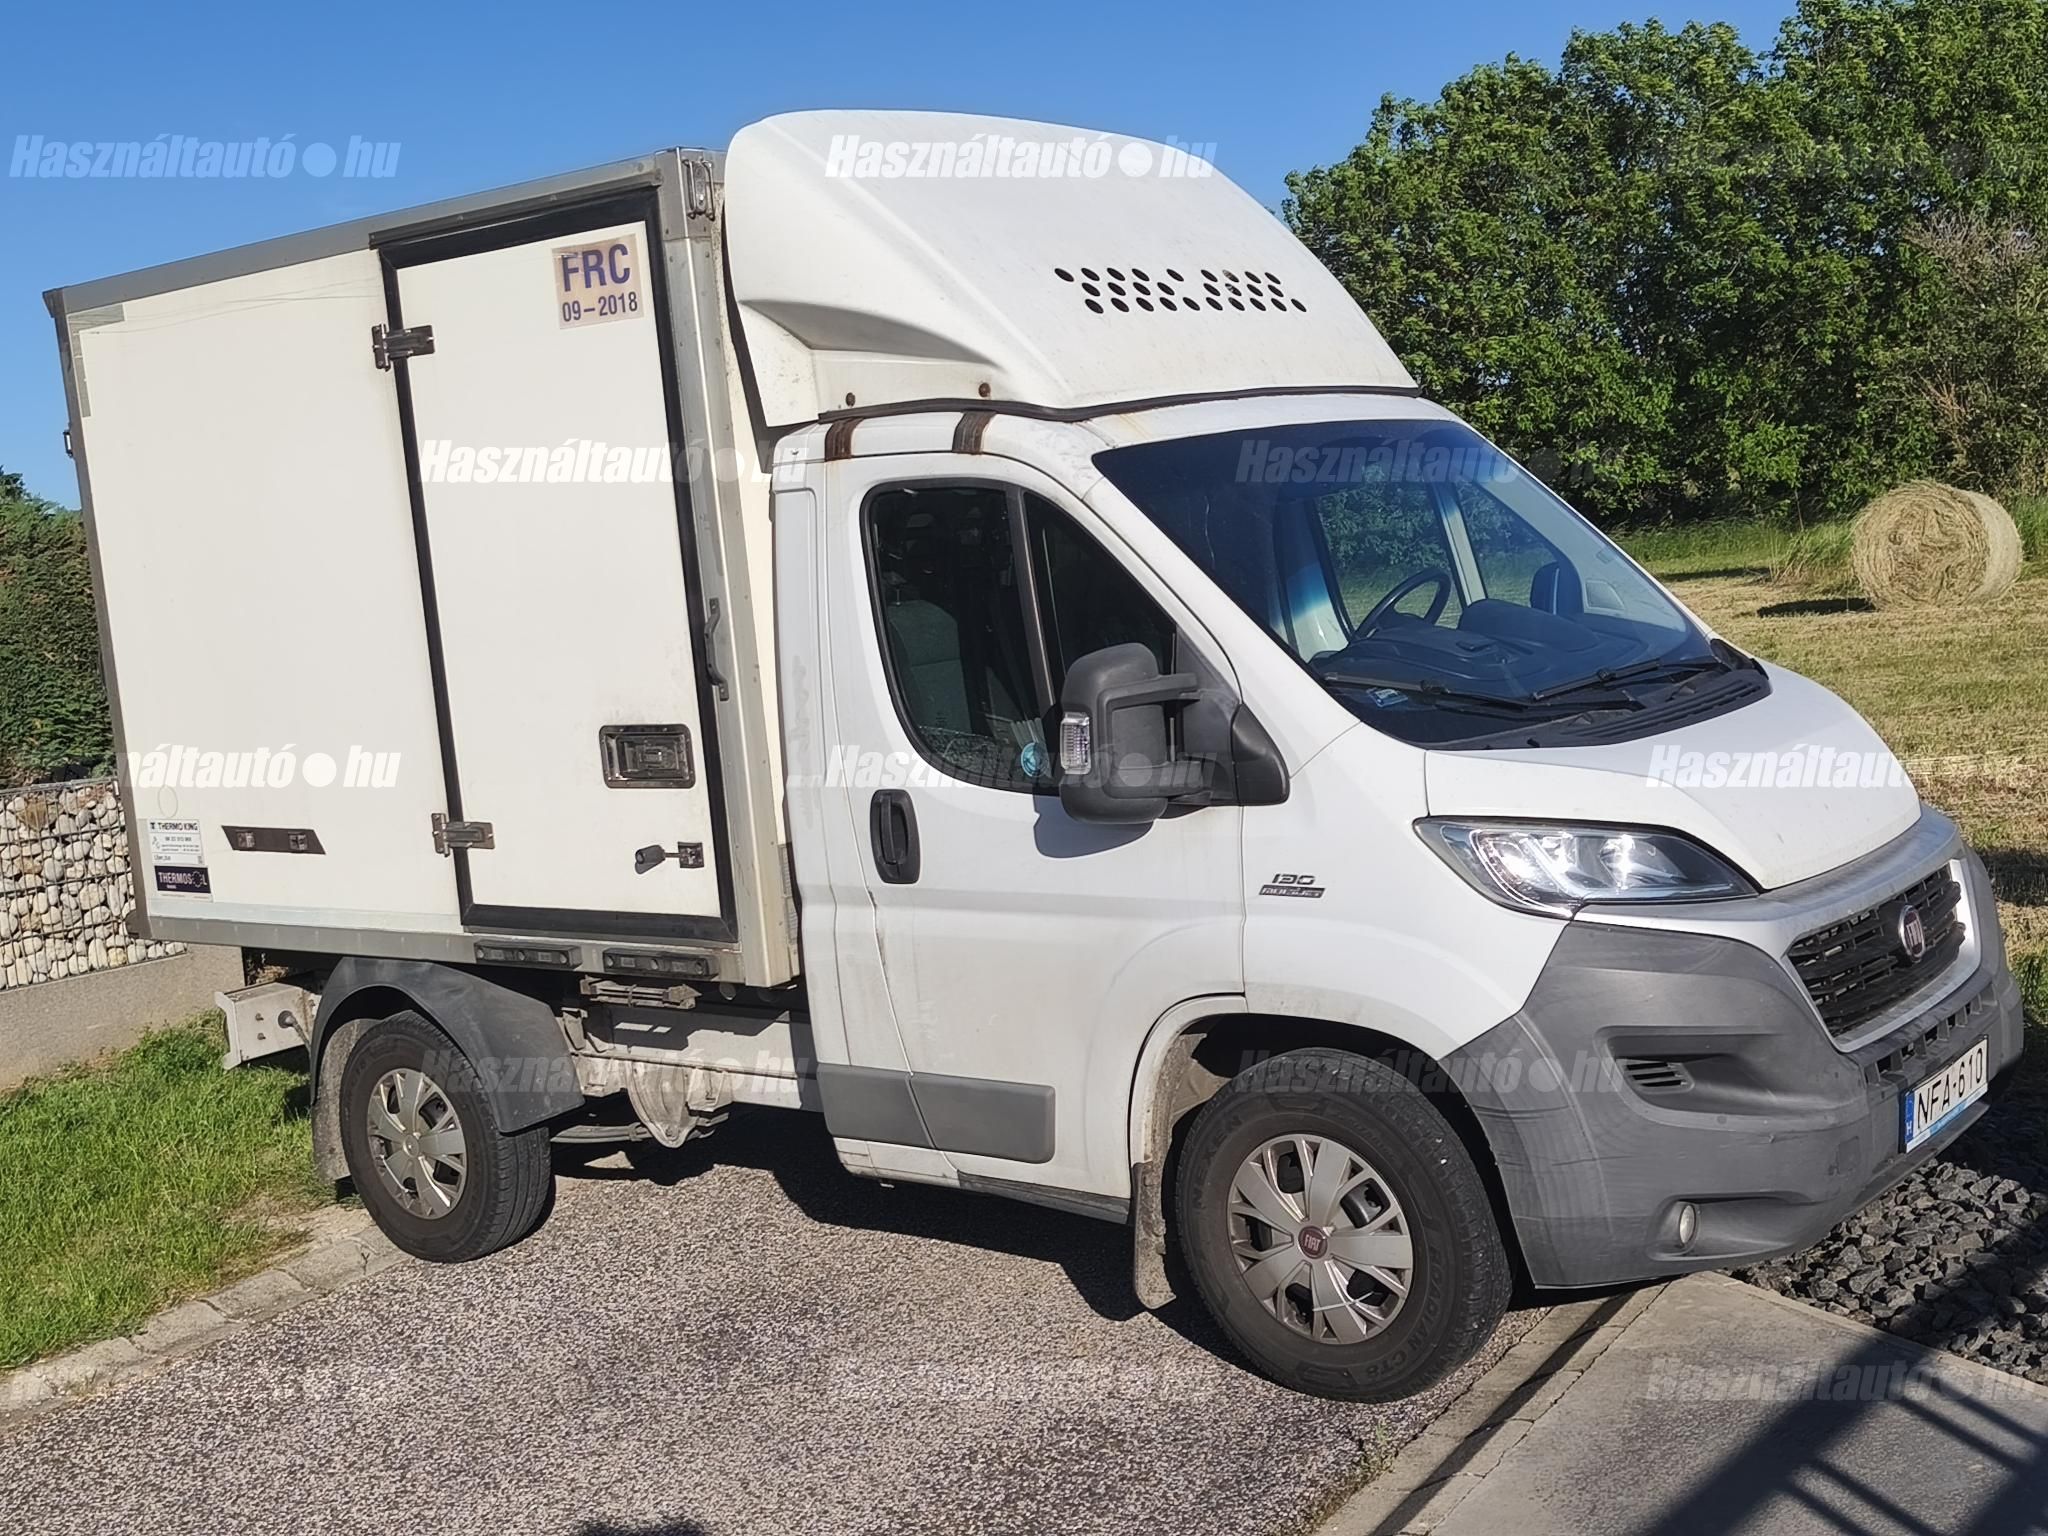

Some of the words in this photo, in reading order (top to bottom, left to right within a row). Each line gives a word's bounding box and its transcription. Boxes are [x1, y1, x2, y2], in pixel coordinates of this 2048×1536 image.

[561, 243, 630, 292] FRC
[1272, 873, 1316, 886] 130
[1918, 1047, 1983, 1130] NFA-610
[1304, 1232, 1322, 1251] FIAT
